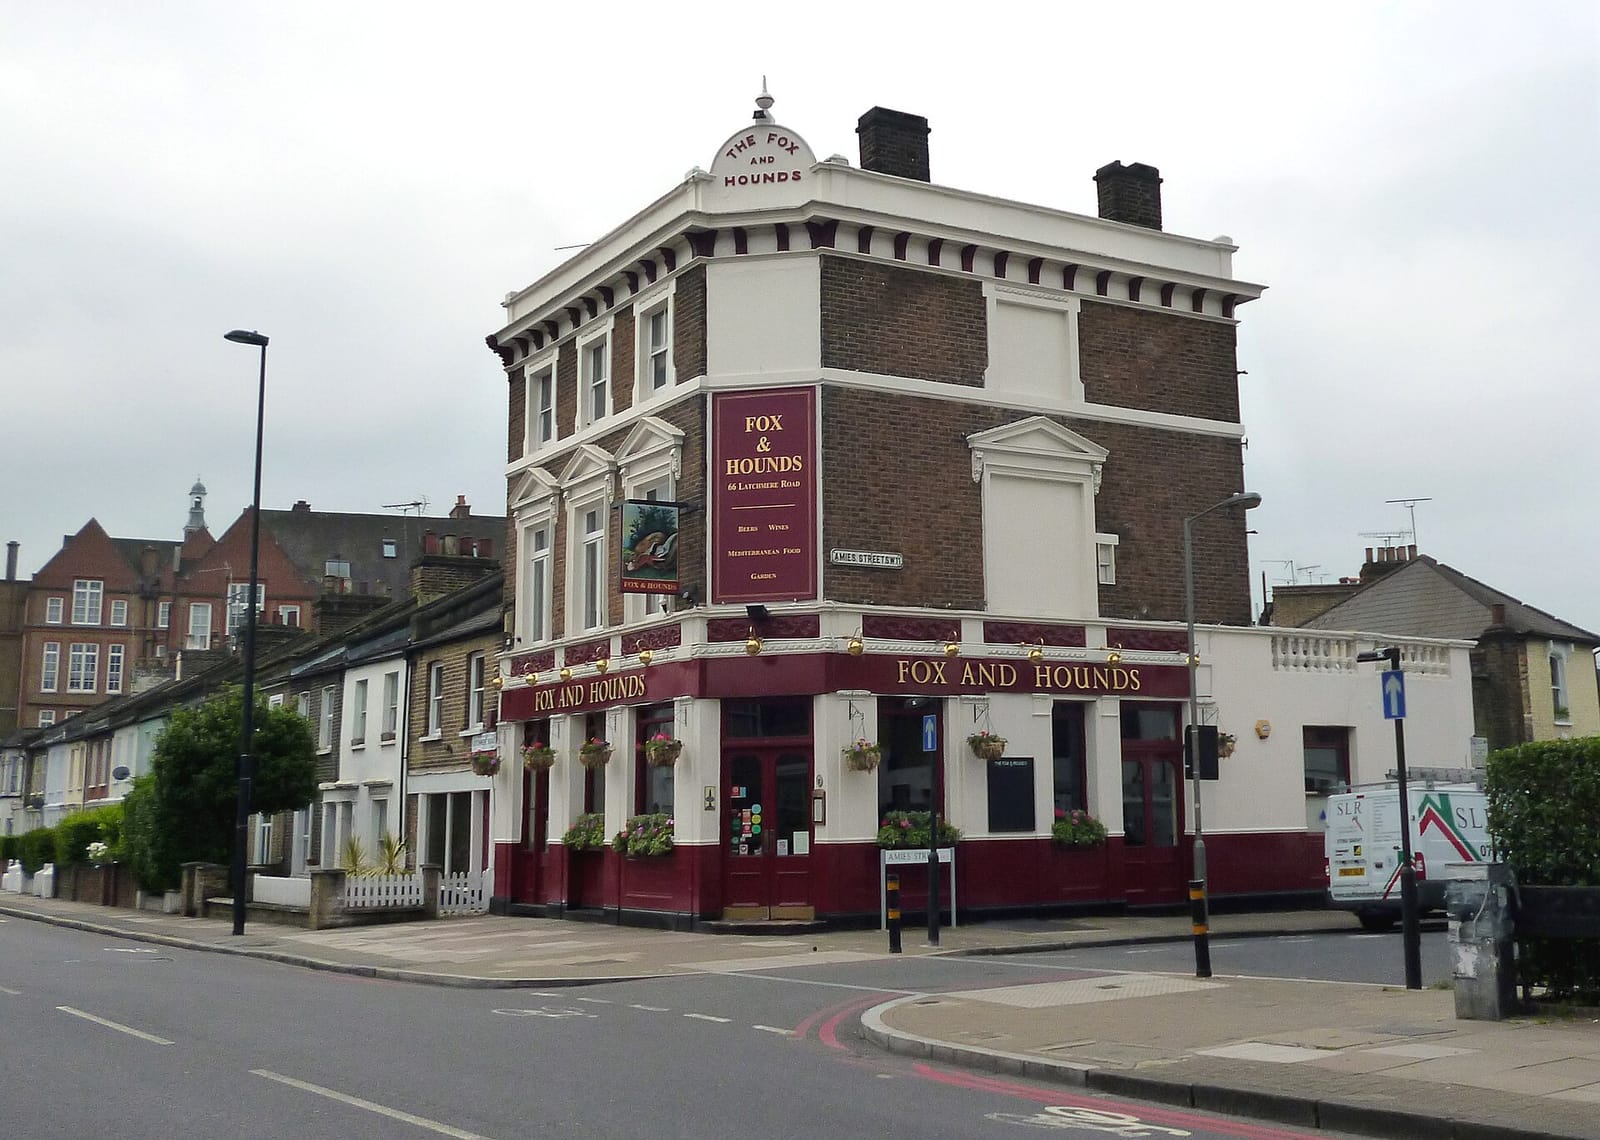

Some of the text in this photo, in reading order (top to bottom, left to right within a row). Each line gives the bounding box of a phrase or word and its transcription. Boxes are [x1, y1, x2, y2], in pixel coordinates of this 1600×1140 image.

[726, 132, 800, 160] THE FOX
[750, 156, 775, 165] AND
[724, 170, 802, 187] HOUNDS
[744, 414, 783, 433] FOX
[756, 436, 771, 453] &
[726, 455, 803, 476] HOUNDS
[727, 482, 737, 491] 66
[834, 552, 857, 562] AMIES
[623, 581, 639, 589] FOX
[897, 660, 1141, 691] FOX AND HOUNDS
[534, 674, 645, 712] FOX AND HOUNDS
[1337, 801, 1362, 815] SLR
